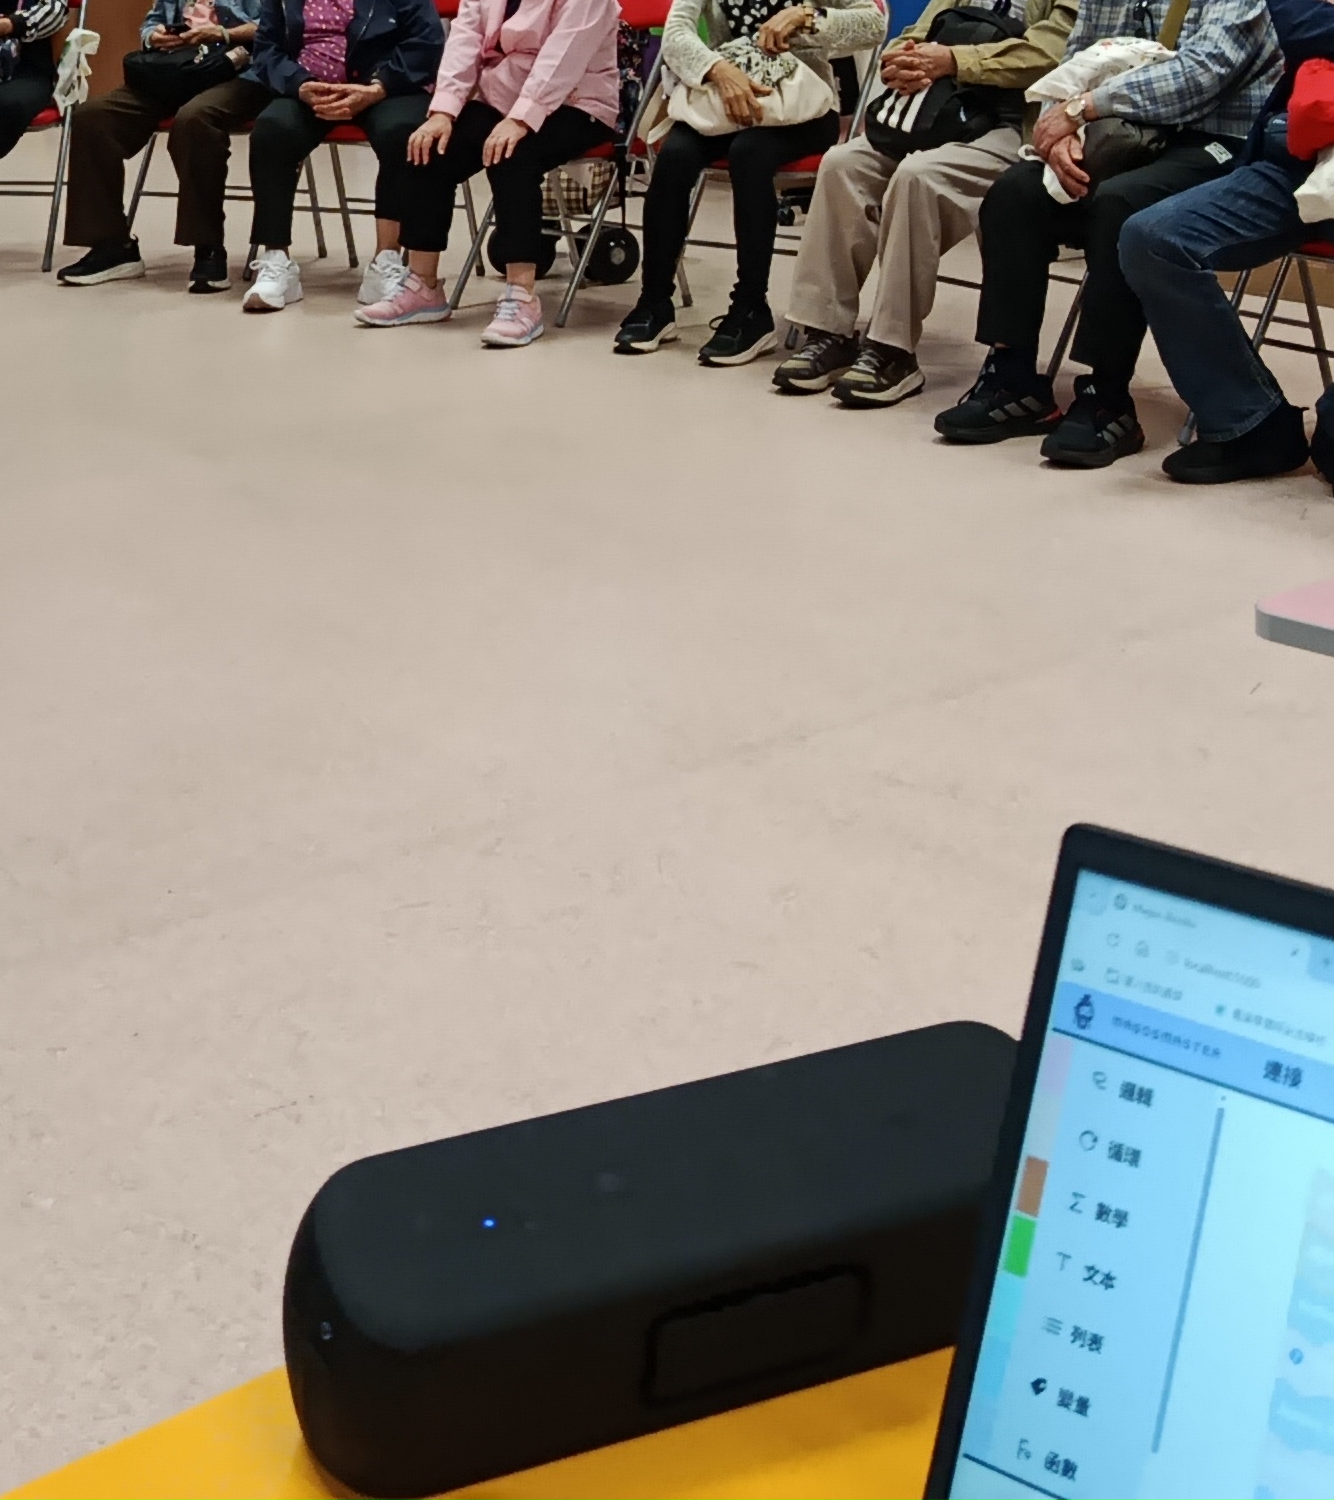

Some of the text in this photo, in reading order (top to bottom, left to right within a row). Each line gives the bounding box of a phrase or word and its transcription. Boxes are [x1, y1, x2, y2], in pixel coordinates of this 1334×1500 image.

[1095, 1202, 1129, 1229] 數學
[1082, 1265, 1117, 1291] 文本
[1070, 1325, 1105, 1355] 列表
[1044, 1450, 1078, 1481] 函數
